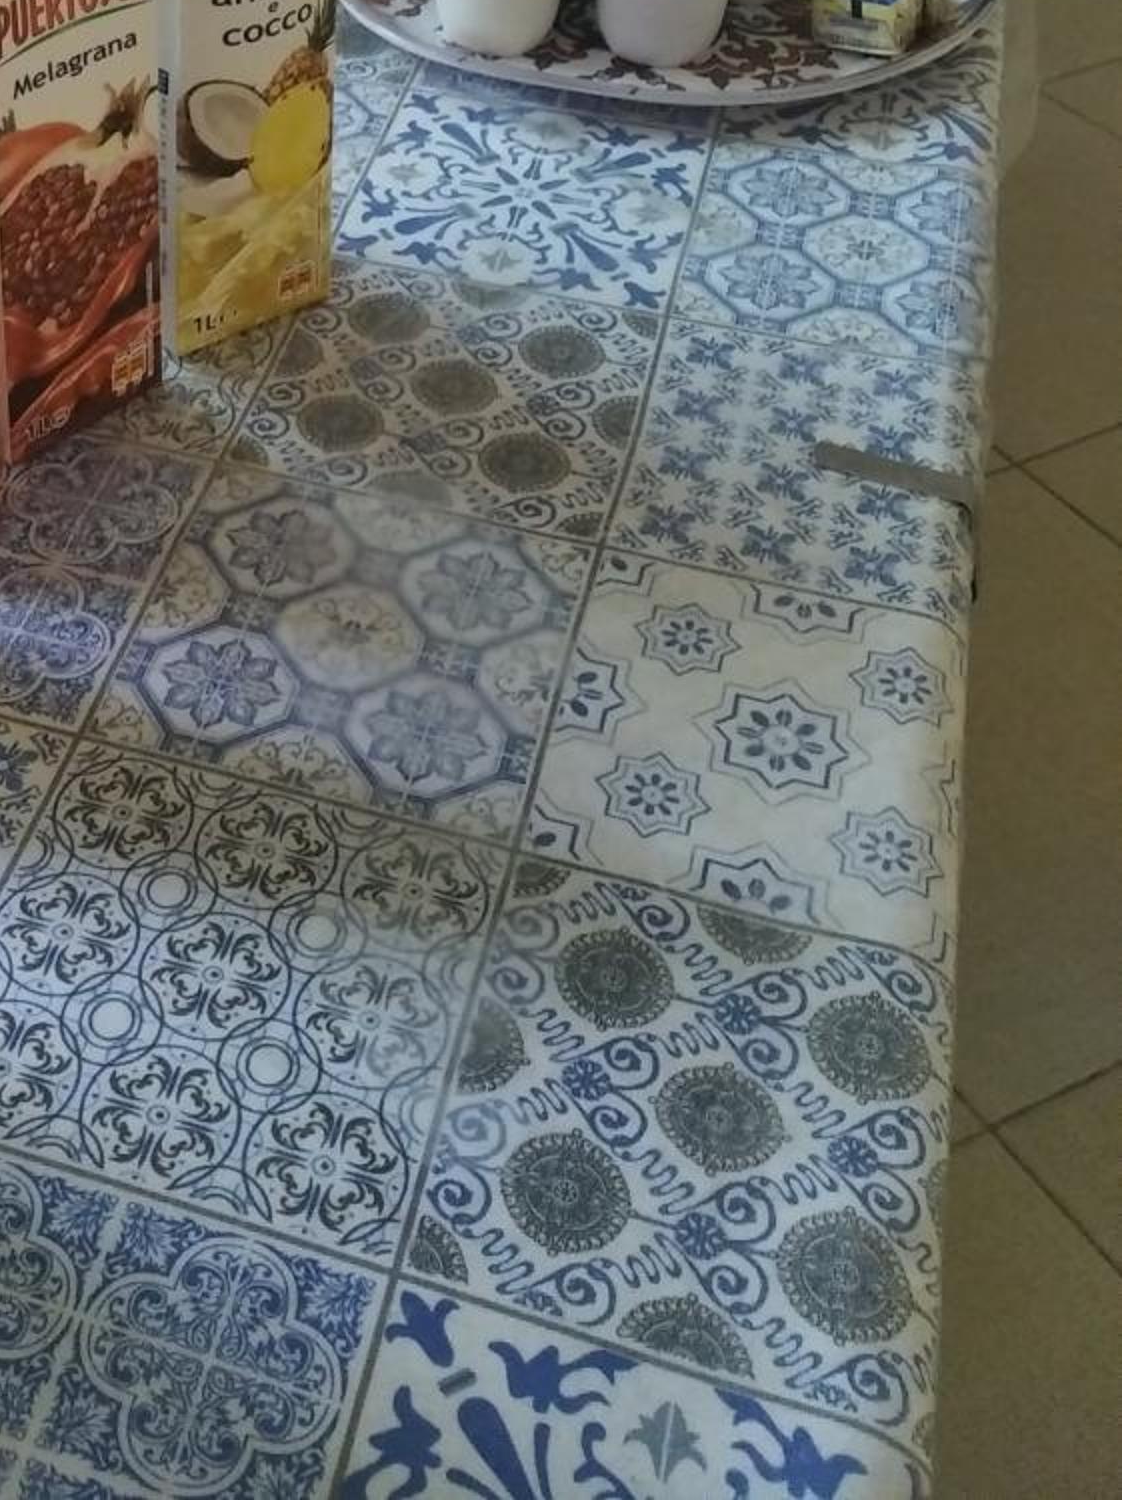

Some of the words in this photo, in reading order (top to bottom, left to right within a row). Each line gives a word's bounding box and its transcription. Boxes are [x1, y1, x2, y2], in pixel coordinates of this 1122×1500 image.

[222, 3, 313, 47] cocco
[268, 1, 280, 13] e
[13, 31, 138, 100] Melagrana
